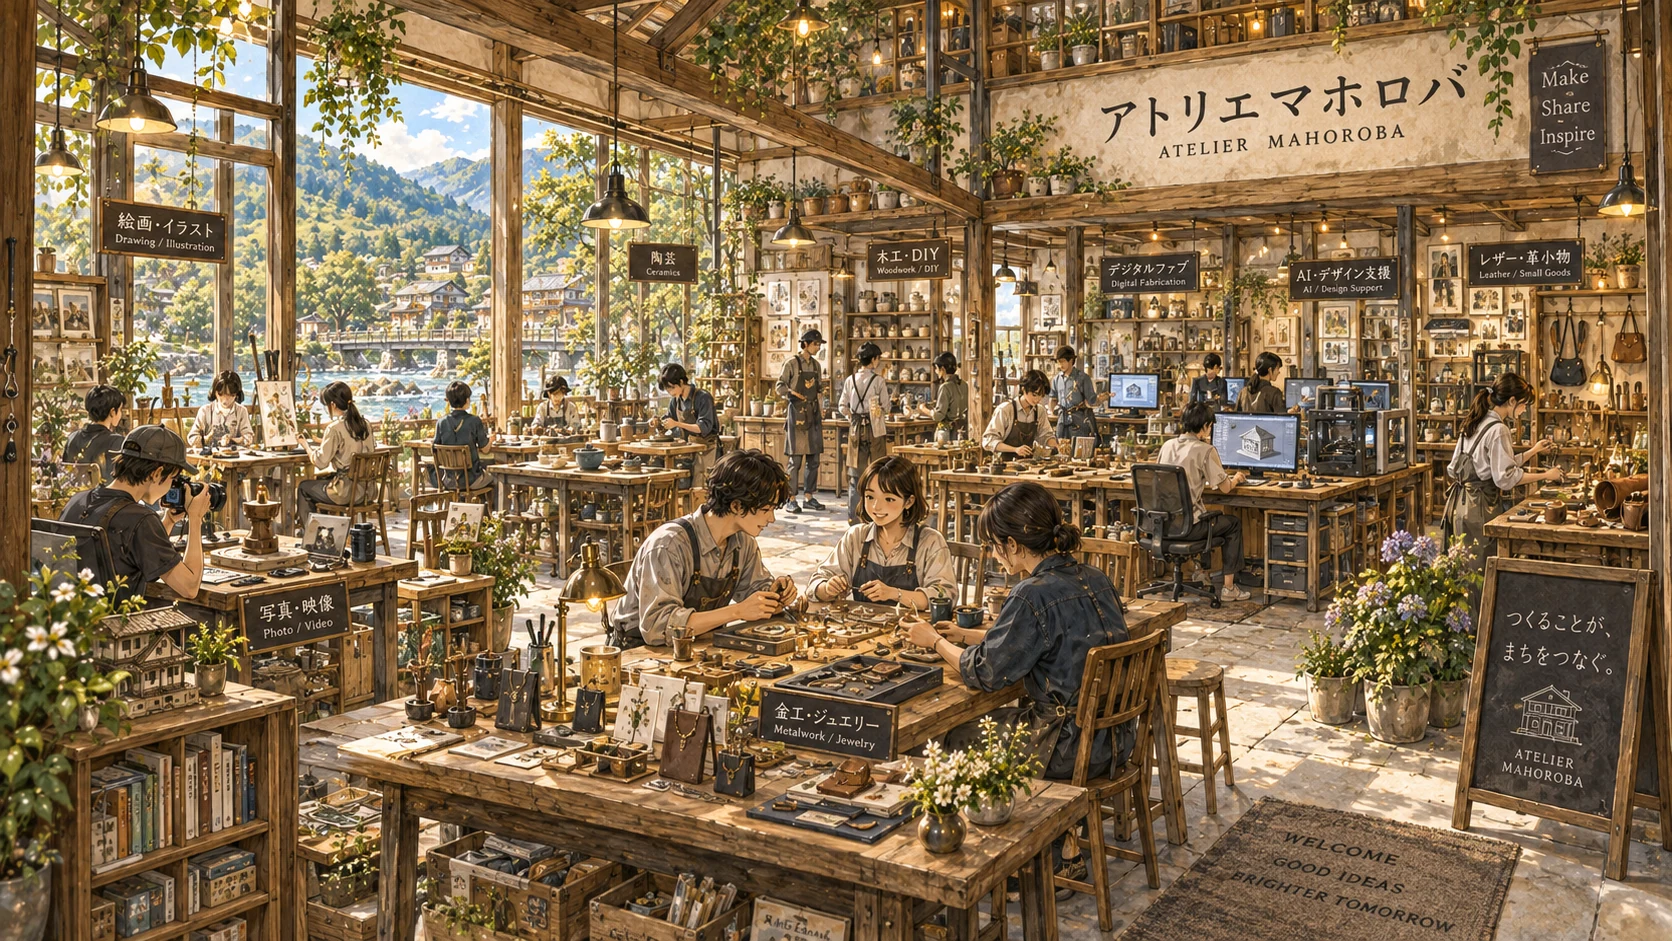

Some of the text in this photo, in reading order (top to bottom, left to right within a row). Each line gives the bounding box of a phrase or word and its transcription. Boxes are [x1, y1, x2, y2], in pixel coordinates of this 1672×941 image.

[1542, 68, 1589, 88] Make
[1100, 63, 1468, 144] アトリエマホロバ
[1541, 98, 1591, 117] Share
[1158, 123, 1405, 159] ATELIER MAHOROBA
[1540, 126, 1595, 147] Inspire
[117, 212, 213, 238] 絵画・イラスト
[115, 233, 156, 248] Drawing
[166, 239, 215, 252] Illustration
[651, 251, 676, 265] 陶芸
[877, 247, 939, 264] 木工・DIY
[1480, 249, 1571, 266] レザー・革小物
[646, 268, 680, 276] Ceramics
[925, 264, 939, 273] DIY
[1480, 269, 1511, 279] Leather
[1520, 269, 1542, 278] Small
[1545, 268, 1571, 277] Goods
[1111, 277, 1186, 289] Digital Fabrication
[1303, 285, 1312, 294] AI
[1321, 284, 1348, 294] Design
[1350, 284, 1383, 294] Support
[260, 594, 335, 622] 写真・映像
[263, 627, 293, 639] Photo
[304, 619, 333, 630] Video
[1507, 610, 1611, 638] つくることが、
[1503, 642, 1613, 675] まちをつなぐ。
[774, 702, 879, 732] 金工・ジュエリー
[773, 724, 826, 741] Metalwork
[836, 735, 875, 751] Jewelry
[1514, 748, 1574, 770] ATELIER
[1502, 761, 1583, 788] MAHOROBA
[1284, 832, 1400, 866] WELCOME
[1273, 857, 1405, 895] GOOD IDEAS
[1231, 871, 1456, 934] BRIGHTER TOMORROW
